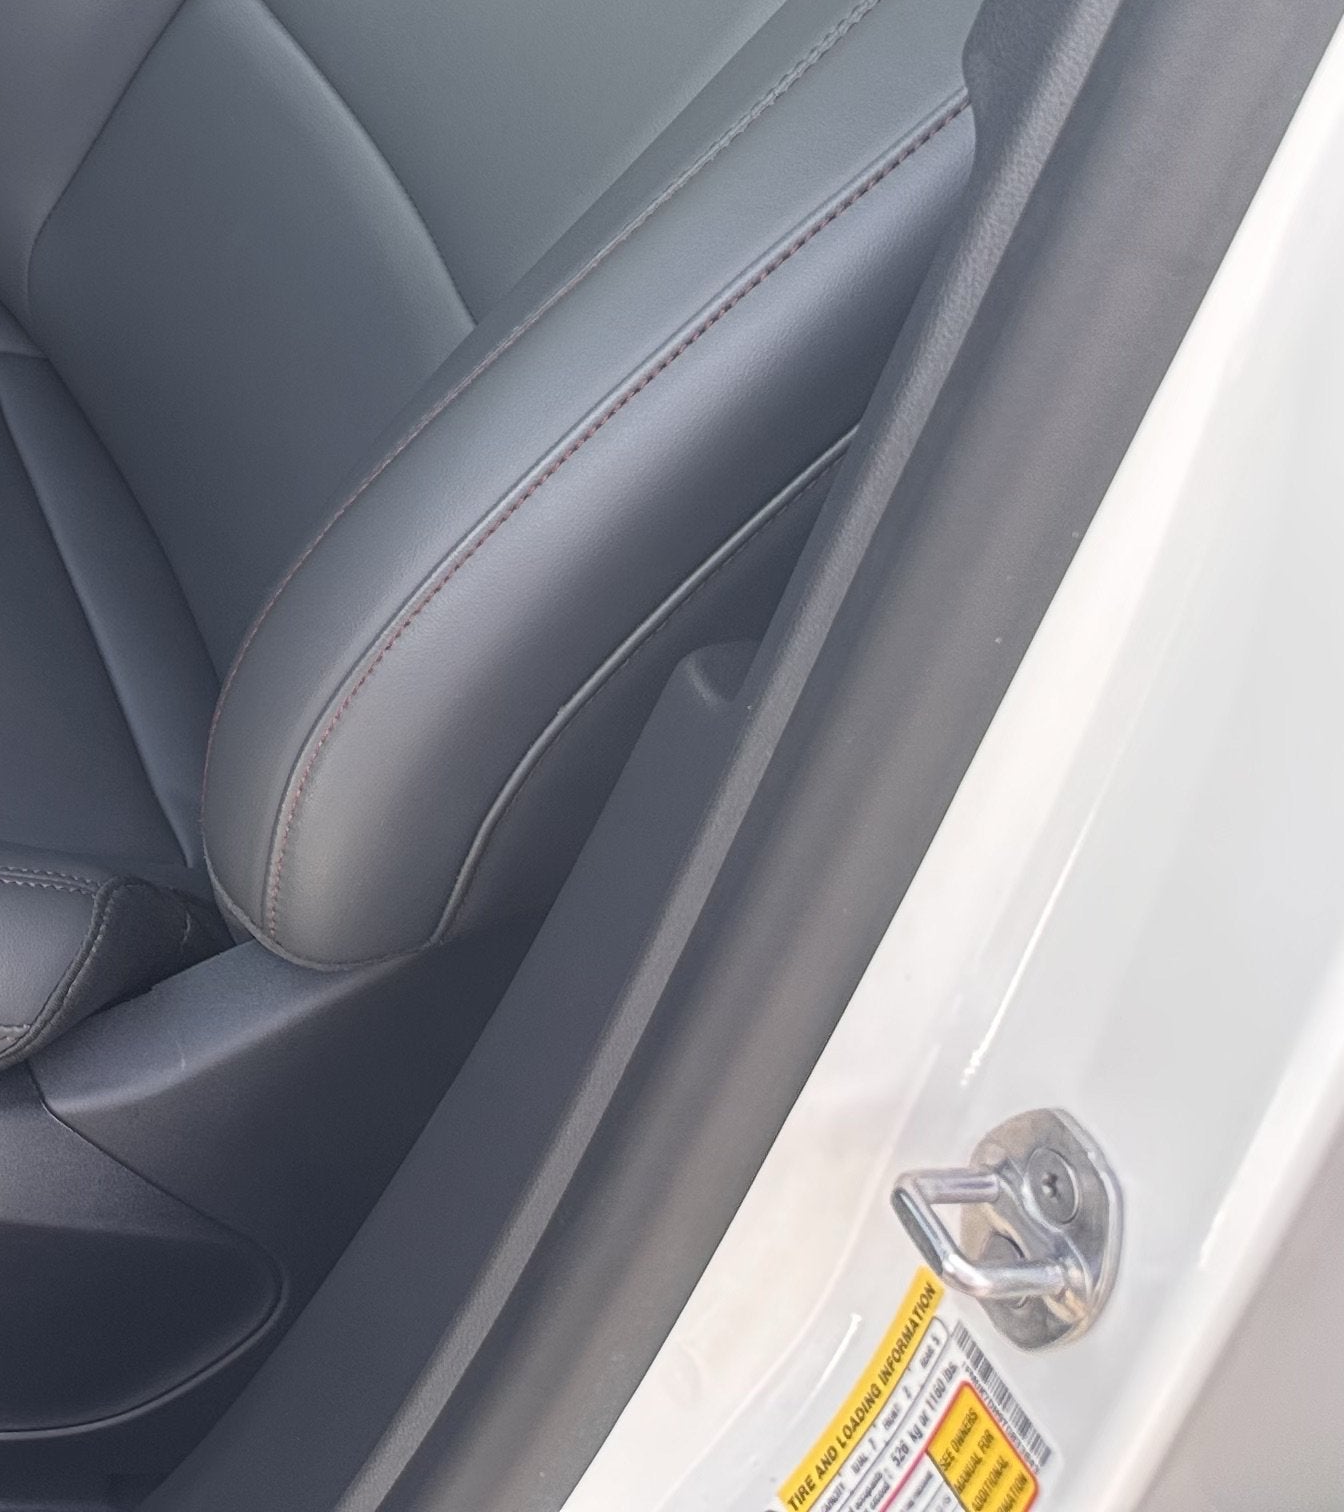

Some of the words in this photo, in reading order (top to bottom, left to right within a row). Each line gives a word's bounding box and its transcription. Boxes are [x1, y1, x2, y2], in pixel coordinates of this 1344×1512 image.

[787, 1473, 816, 1511] TIRE
[815, 1445, 838, 1480] AND
[836, 1383, 882, 1449] LOADING
[877, 1281, 936, 1386] INFORMATION
[891, 1439, 910, 1467] 526
[925, 1377, 946, 1411] 1160
[939, 1448, 956, 1472] SEE
[950, 1407, 979, 1453] OWNERS
[954, 1451, 983, 1494] MANUAL
[977, 1428, 995, 1455] FOR
[972, 1455, 1009, 1512] ADDITIONAL
